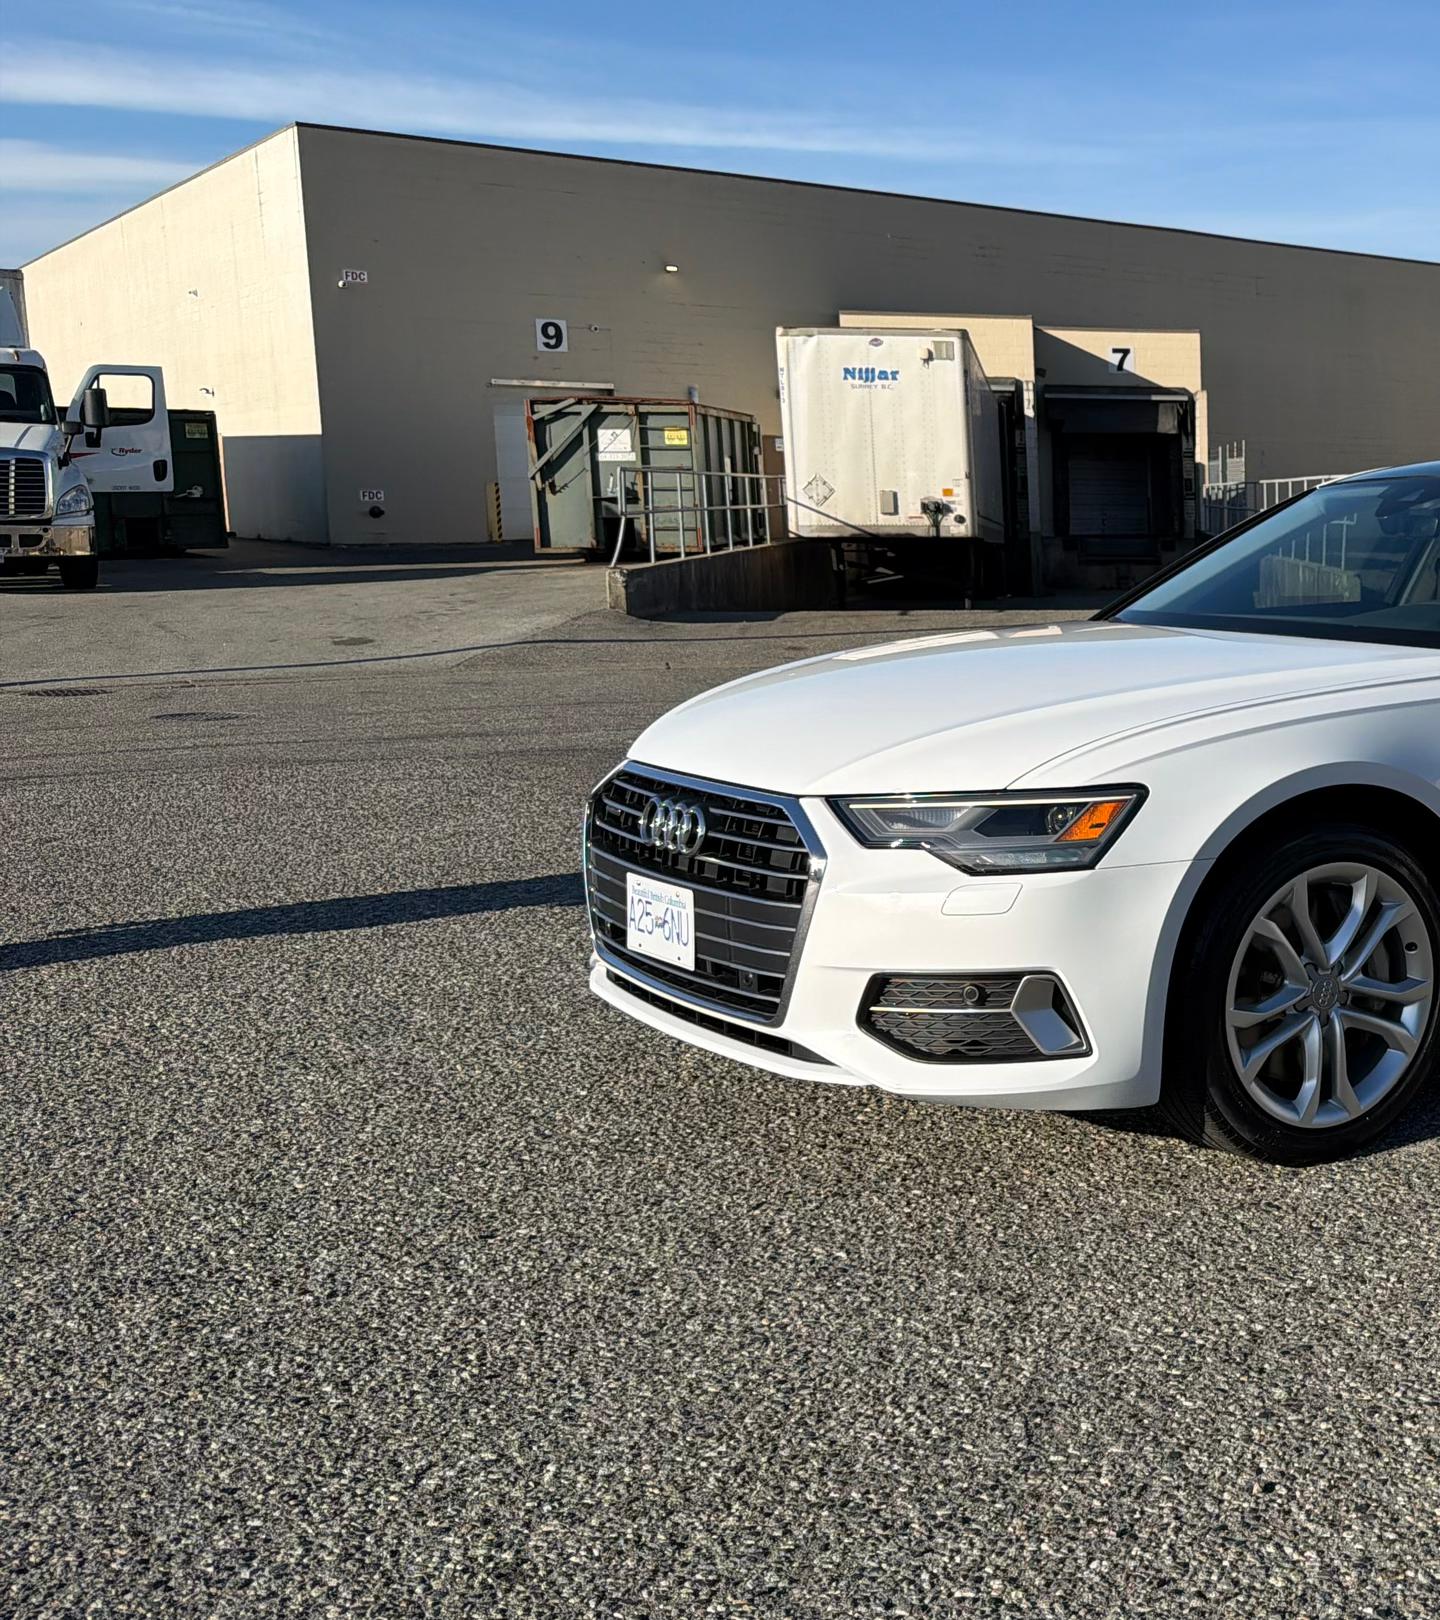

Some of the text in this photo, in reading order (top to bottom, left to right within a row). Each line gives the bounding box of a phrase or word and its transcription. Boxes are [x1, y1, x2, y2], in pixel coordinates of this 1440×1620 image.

[345, 271, 366, 282] FDC
[541, 321, 563, 349] 9
[1112, 348, 1130, 371] 7
[843, 367, 900, 383] Nijjar
[118, 447, 142, 456] Ryder
[362, 490, 383, 500] FDC
[629, 896, 690, 947] A25 6NU
